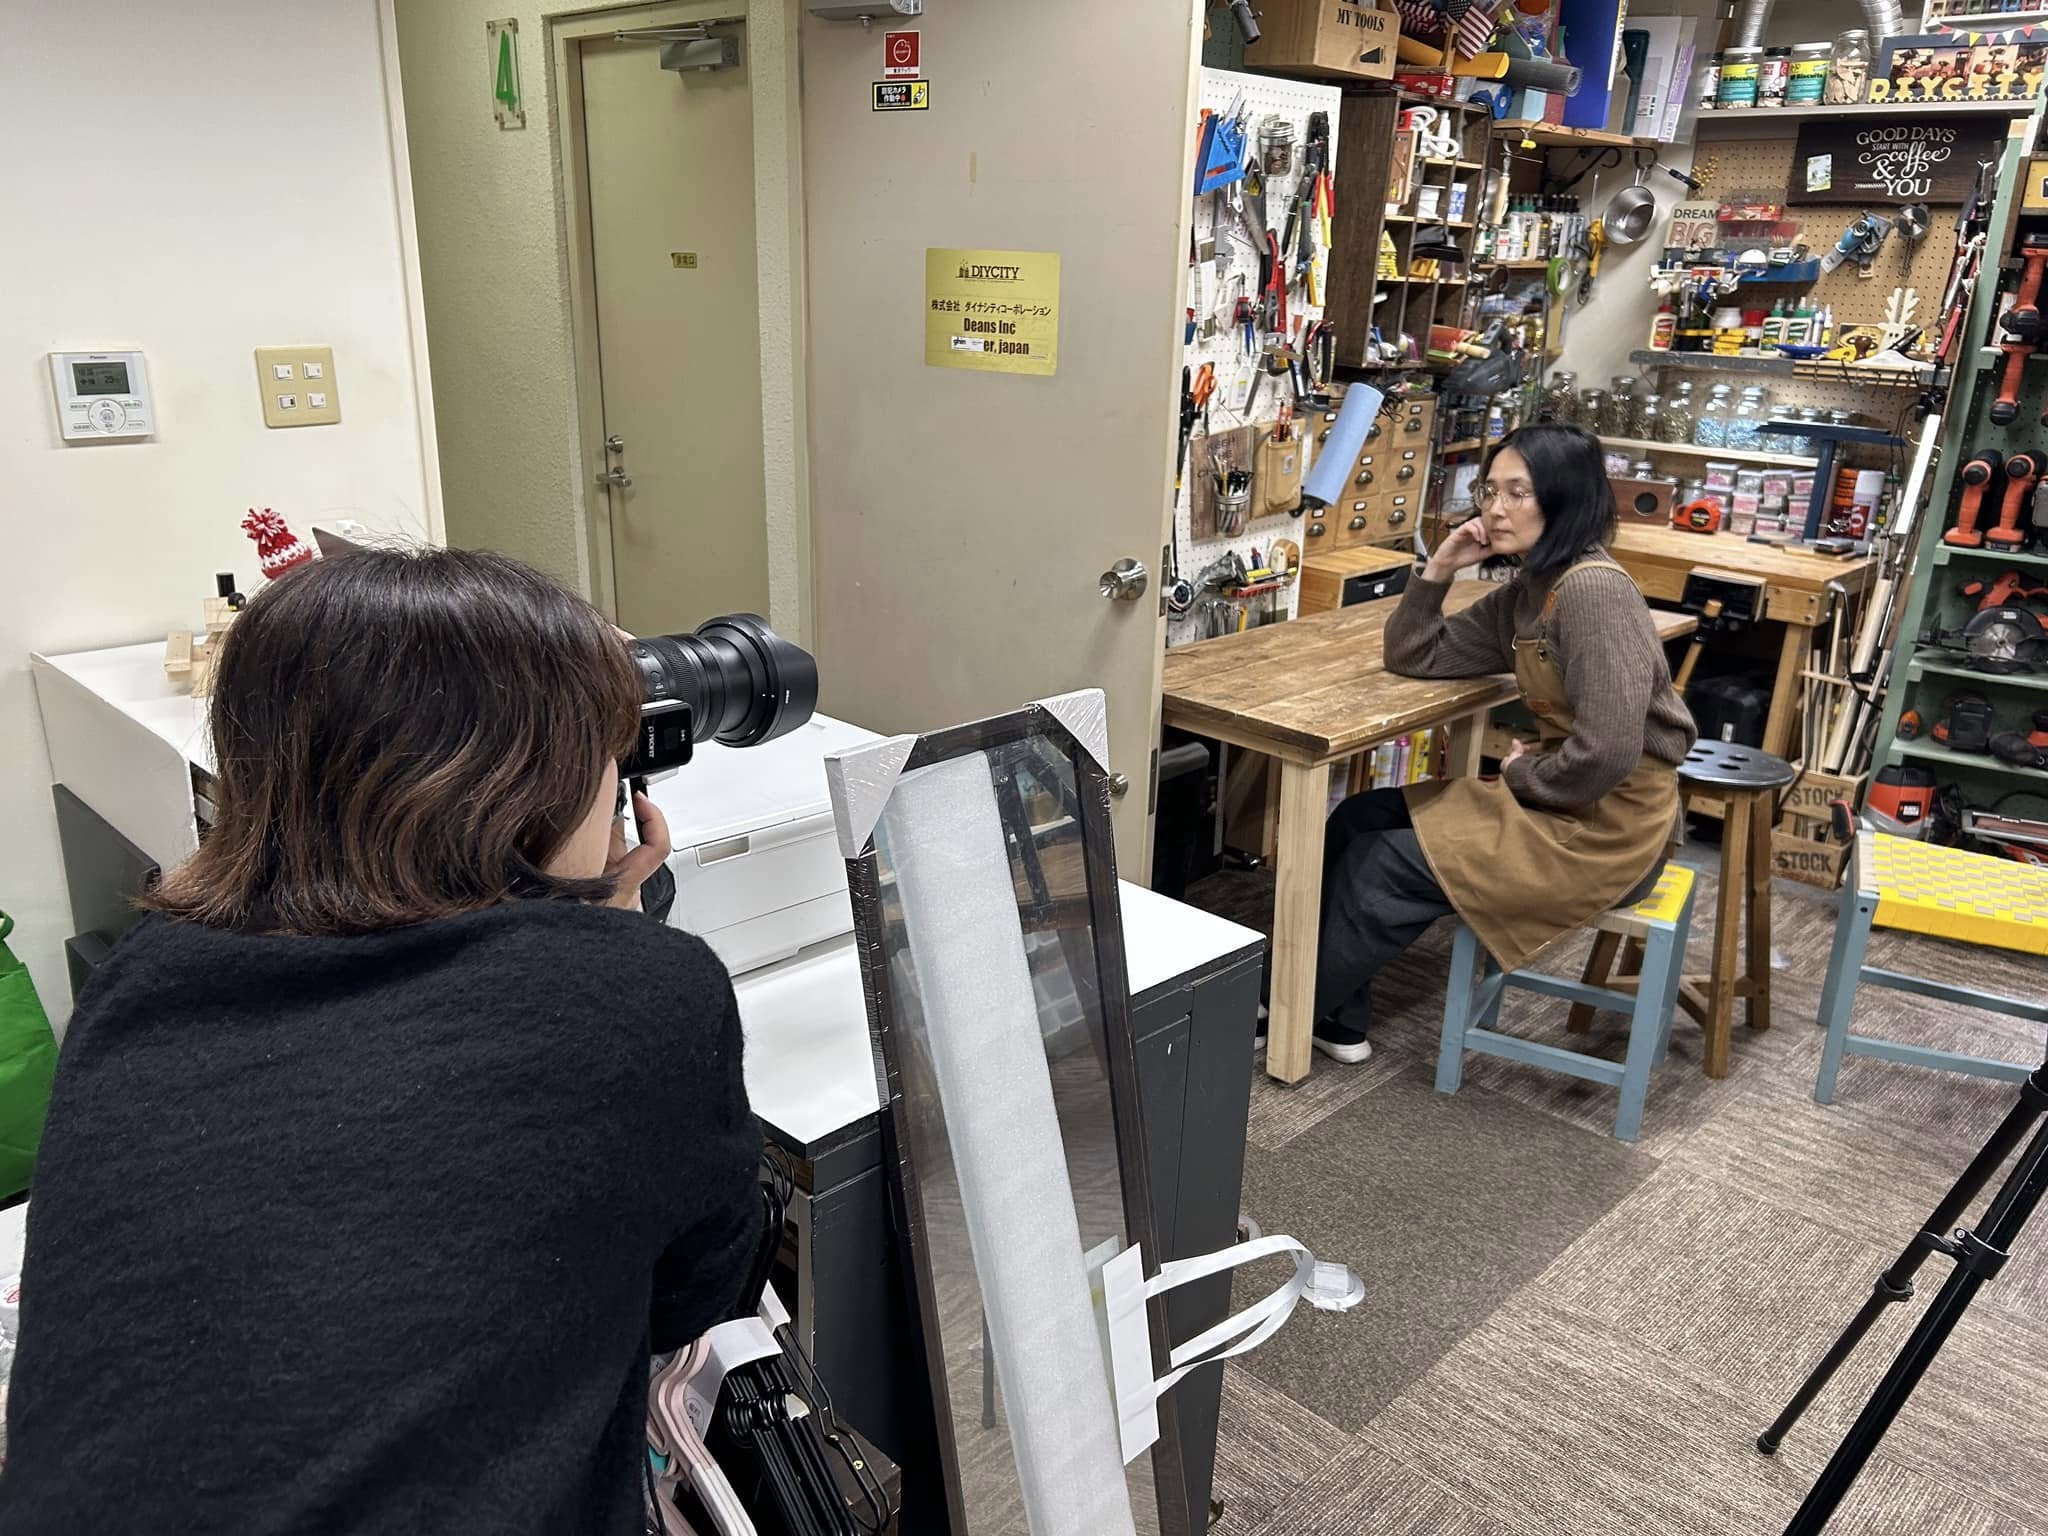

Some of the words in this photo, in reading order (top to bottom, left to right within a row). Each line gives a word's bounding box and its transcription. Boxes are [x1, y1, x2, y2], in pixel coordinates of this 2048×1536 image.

[1336, 8, 1352, 25] MY
[1354, 11, 1385, 32] TOOLS
[1868, 72, 2043, 103] DIYCITY
[1856, 127, 1908, 145] GOOD
[1911, 127, 1957, 143] DAYS
[1872, 143, 1891, 151] START
[1858, 141, 1951, 178] coffee
[1872, 158, 1897, 180] &
[1884, 178, 1932, 196] YOU
[1673, 208, 1719, 219] DREAM
[1669, 222, 1714, 246] BIG
[971, 265, 1020, 279] DIYCITY
[931, 300, 961, 312] 株式会社
[964, 302, 1052, 316] ダイナシティコーポレーション
[963, 318, 997, 334] Deans
[999, 320, 1016, 335] Inc
[998, 340, 1030, 356] japan
[1776, 851, 1833, 873] STOCK
